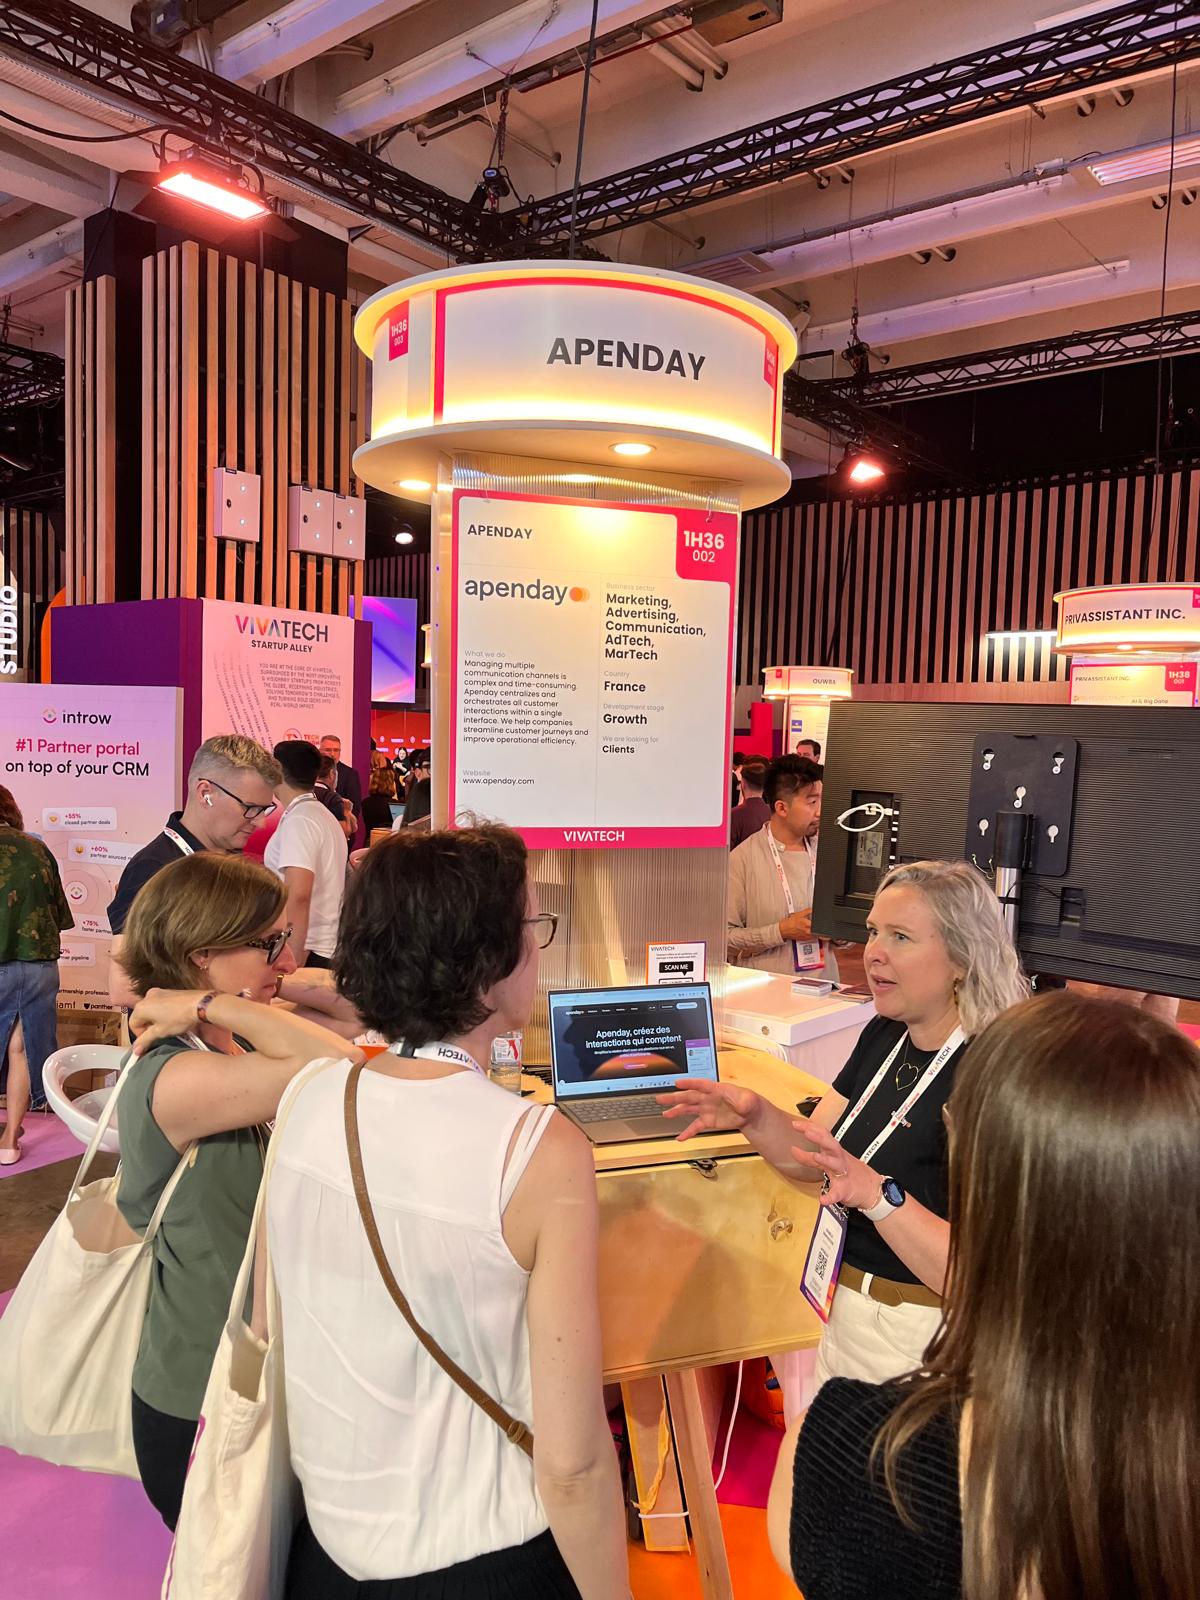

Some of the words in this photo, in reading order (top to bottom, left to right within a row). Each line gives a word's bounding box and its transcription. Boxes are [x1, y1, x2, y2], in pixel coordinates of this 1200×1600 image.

[391, 319, 407, 337] 1H36
[547, 338, 705, 380] APENDAY
[467, 524, 532, 539] APENDAY
[684, 530, 725, 549] 1H36
[693, 549, 716, 562] 002
[465, 579, 568, 605] apenday
[606, 593, 671, 609] Marketing,
[606, 607, 679, 623] Advertising,
[1065, 609, 1152, 625] PRIVASSISTANT
[1156, 609, 1186, 620] INC.
[0, 586, 17, 675] STUDIO
[235, 615, 328, 642] VIVATECH
[606, 621, 706, 637] Communication,
[251, 640, 288, 650] STARTUP
[290, 644, 313, 653] ALLEY
[605, 634, 654, 648] AdTech,
[605, 648, 657, 660] MarTech
[465, 660, 502, 669] Managing
[505, 662, 535, 670] multiple
[464, 670, 524, 678] communication
[604, 670, 630, 678] Country
[464, 689, 498, 697] Apenday
[604, 681, 646, 692] France
[62, 710, 112, 724] introw
[541, 710, 562, 718] single
[603, 714, 647, 724] Growth
[515, 718, 530, 726] help
[532, 719, 573, 727] companies
[542, 728, 573, 736] journeys
[496, 736, 539, 744] operational
[541, 737, 576, 746] efficiency.
[626, 736, 649, 744] looking
[16, 738, 32, 752] #1
[38, 739, 92, 754] Partner
[96, 742, 139, 758] portal
[602, 745, 635, 754] Clients
[5, 762, 23, 772] on
[28, 760, 52, 776] top
[57, 760, 72, 773] of
[75, 764, 108, 777] your
[113, 762, 149, 776] CRM
[463, 778, 534, 786] www.apenday.com
[563, 830, 625, 842] VIVATECH
[596, 1028, 632, 1039] Apenday,
[633, 1027, 654, 1035] créez
[657, 1026, 670, 1034] des
[632, 1036, 644, 1046] qui
[645, 1035, 682, 1045] comptent
